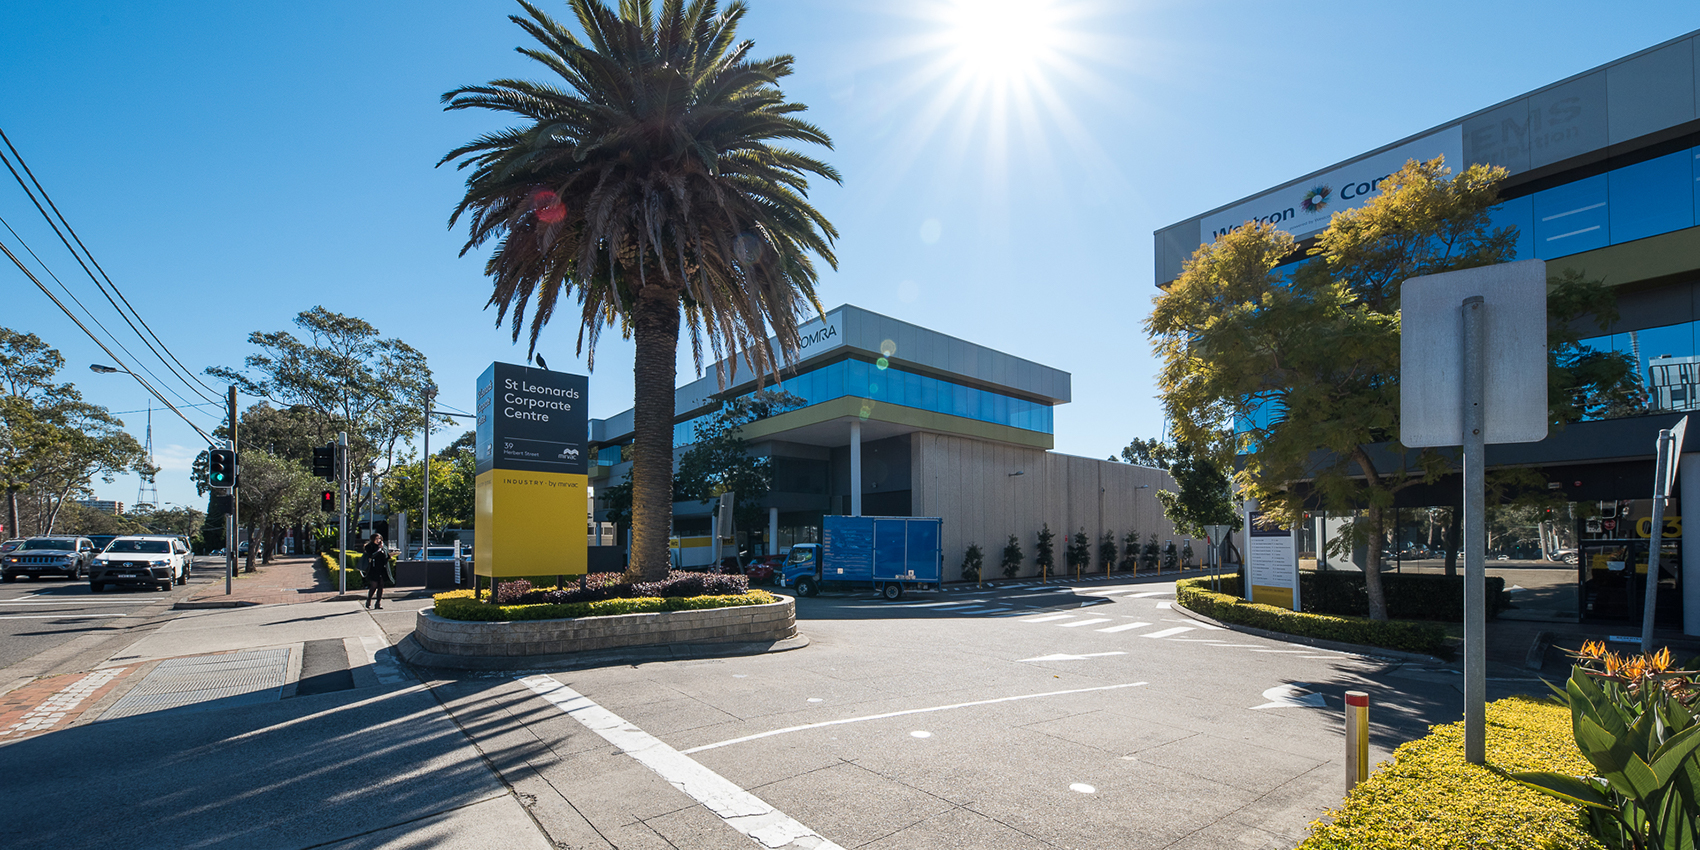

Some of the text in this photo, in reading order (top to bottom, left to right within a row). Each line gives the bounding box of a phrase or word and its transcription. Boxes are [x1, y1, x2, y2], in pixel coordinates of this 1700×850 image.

[1213, 207, 1295, 240] Wtcon
[800, 325, 837, 349] OMRA
[504, 378, 519, 391] St
[522, 381, 580, 399] Leonards
[504, 393, 571, 411] Corporate
[504, 407, 550, 422] Centre
[504, 442, 514, 450] 39
[548, 480, 557, 488] by
[1636, 516, 1683, 539] 03
